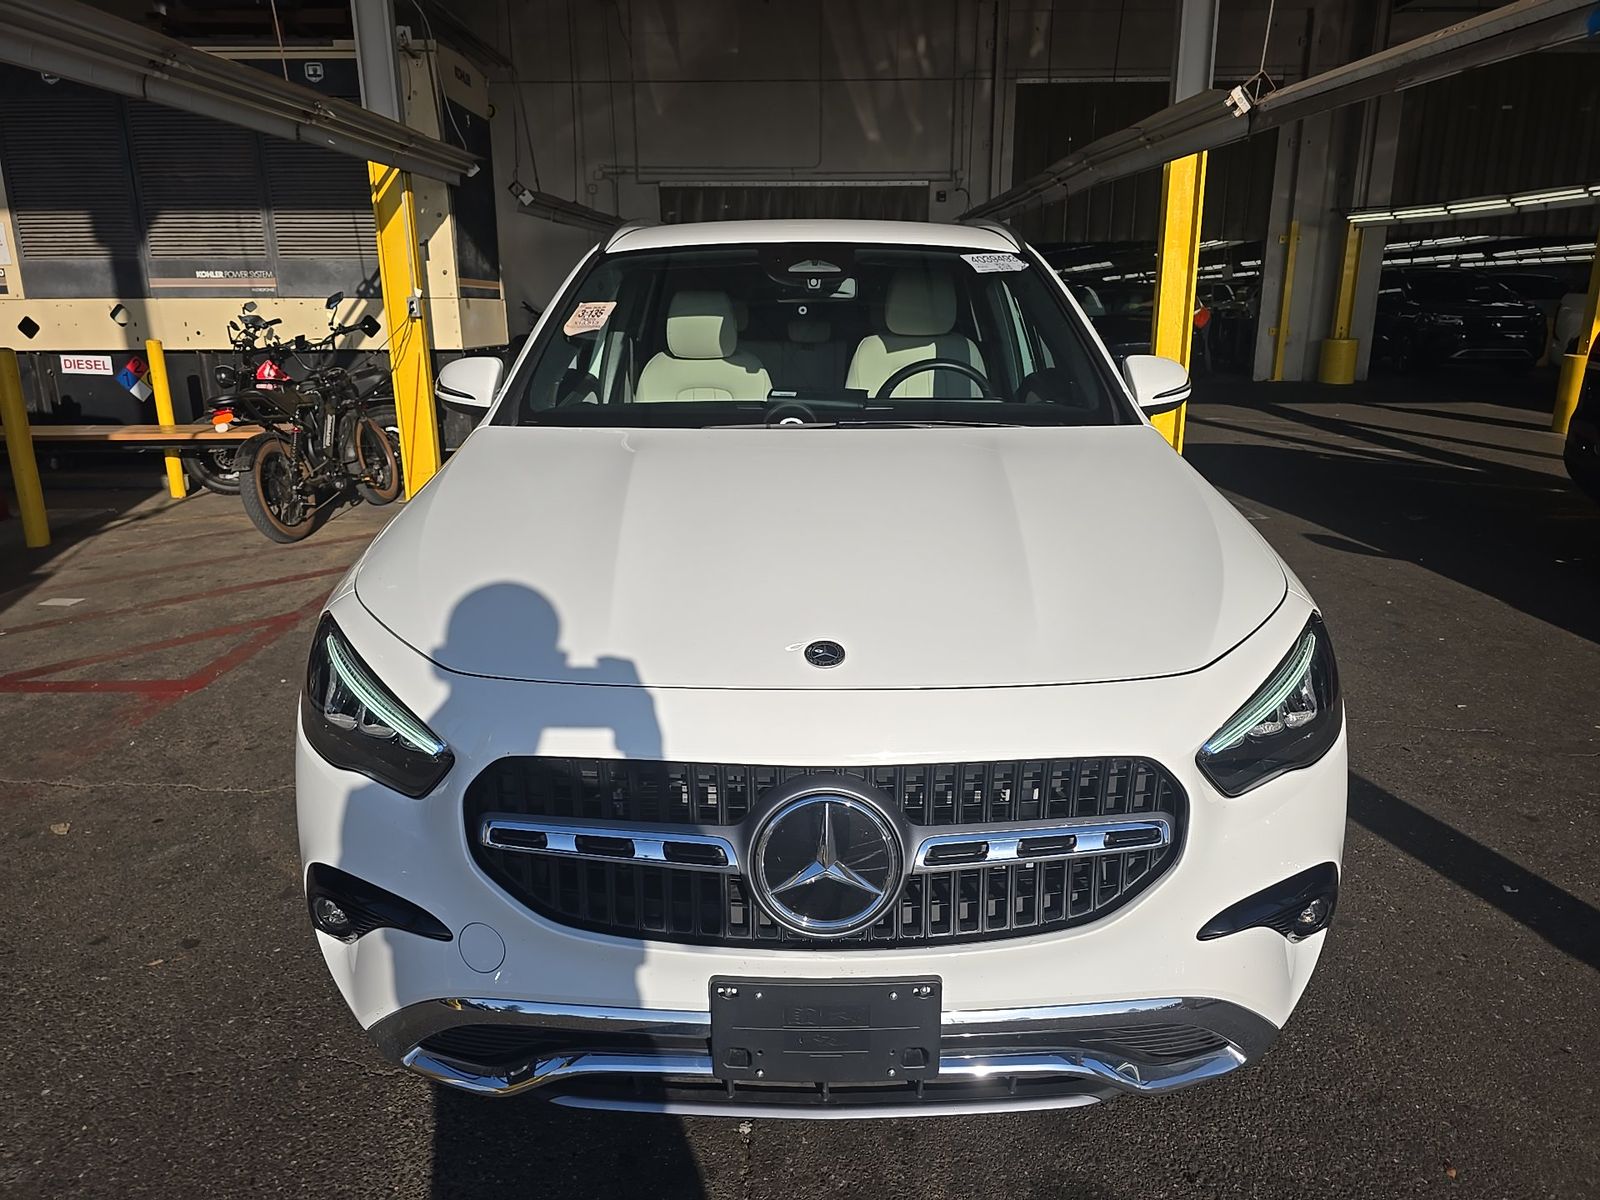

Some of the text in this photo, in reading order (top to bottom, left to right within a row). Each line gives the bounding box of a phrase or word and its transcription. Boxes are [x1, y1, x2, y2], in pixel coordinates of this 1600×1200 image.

[196, 270, 223, 278] KOHLER
[224, 270, 248, 278] POWER
[63, 359, 110, 371] DIESEL
[132, 358, 144, 374] 2
[123, 372, 131, 387] 1
